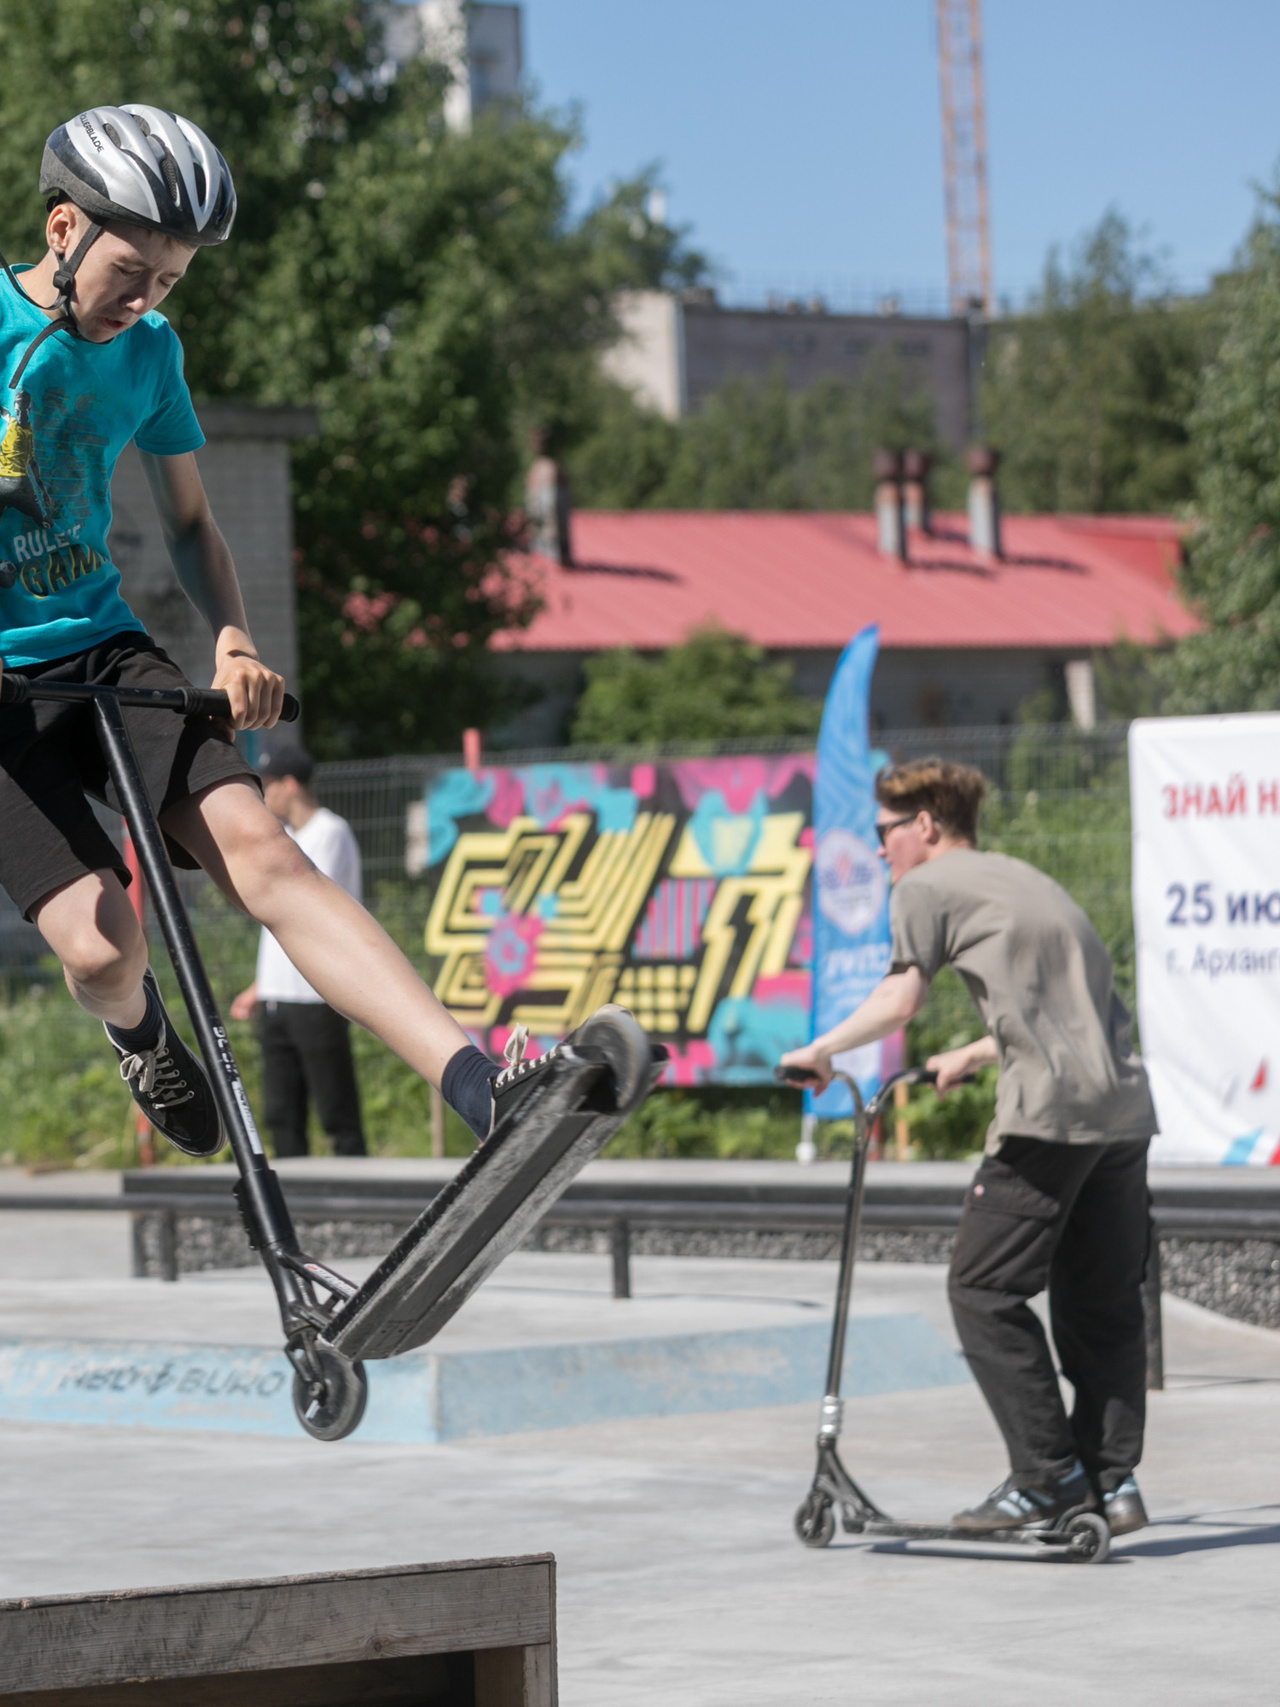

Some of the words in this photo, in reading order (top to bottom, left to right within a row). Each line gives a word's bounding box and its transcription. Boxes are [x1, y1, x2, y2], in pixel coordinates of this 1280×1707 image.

[20, 544, 106, 600] GAM
[1163, 773, 1246, 820] ЗНАЙ
[1258, 779, 1280, 817] Н
[1167, 882, 1215, 926] 25
